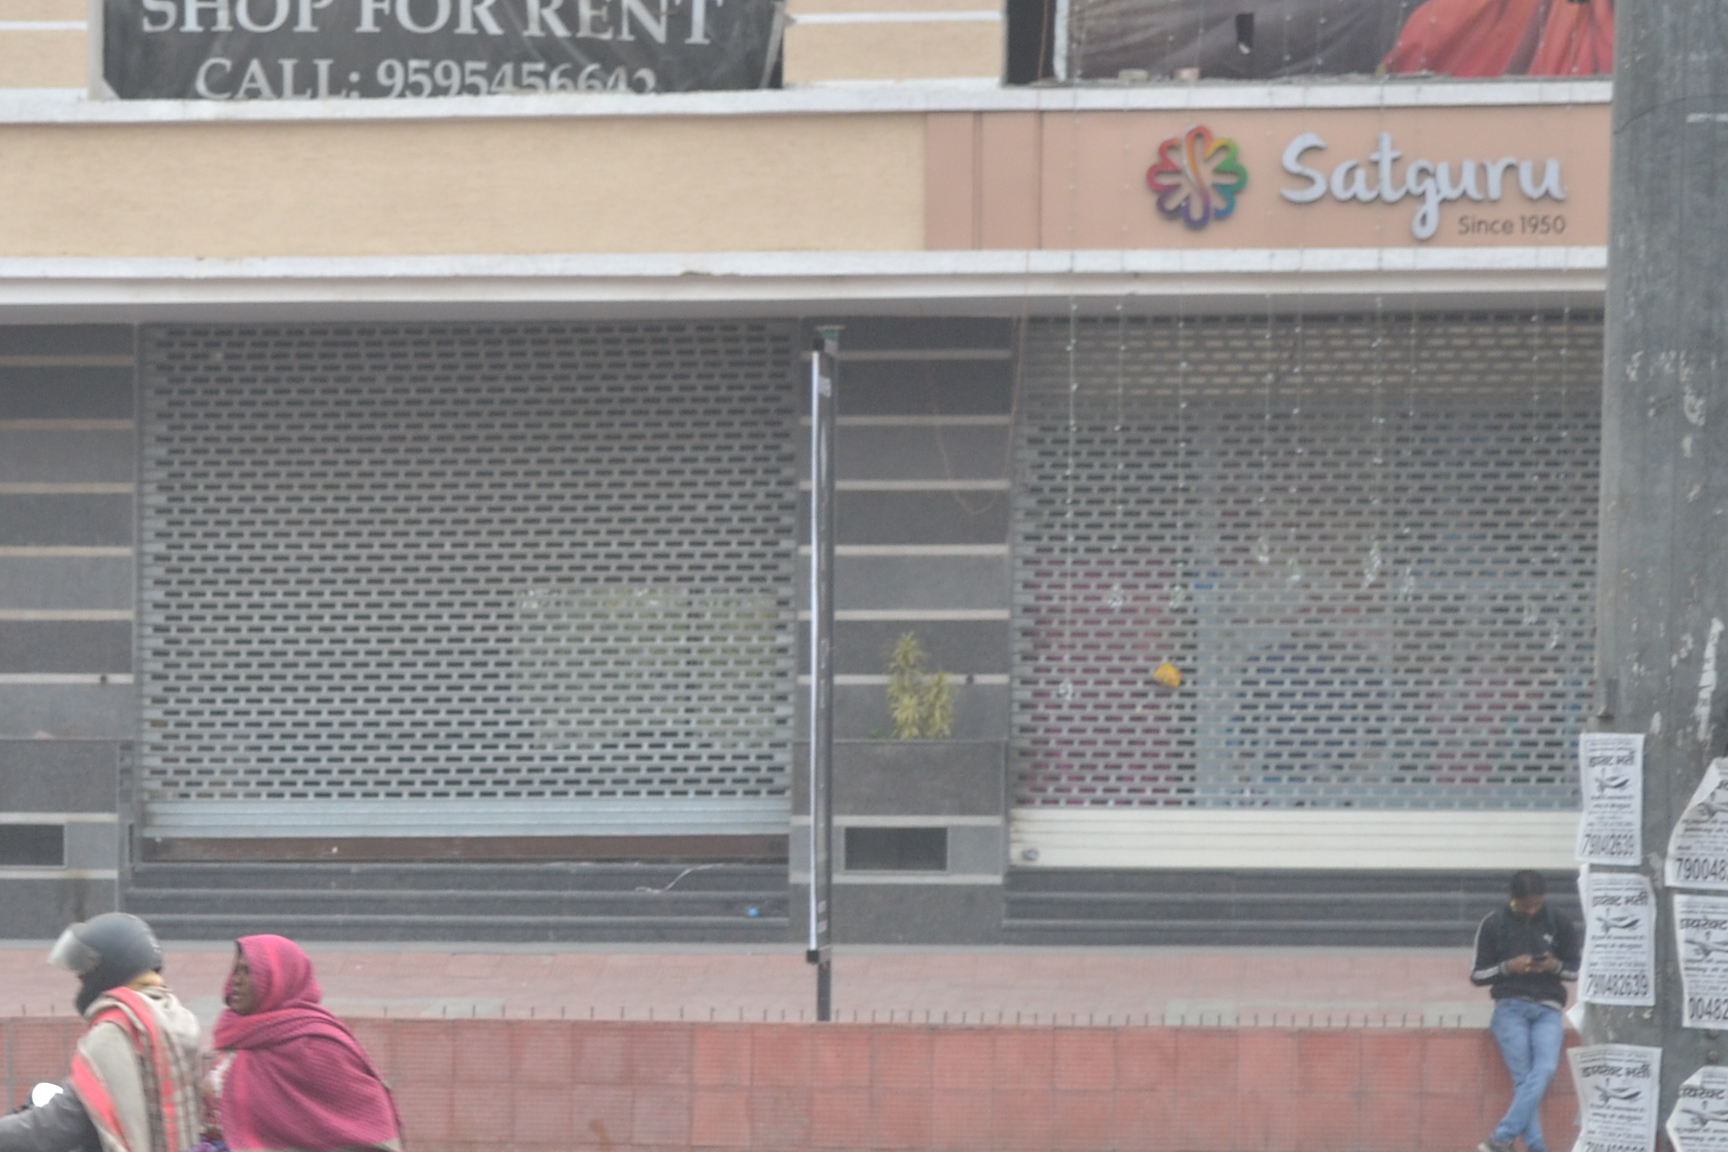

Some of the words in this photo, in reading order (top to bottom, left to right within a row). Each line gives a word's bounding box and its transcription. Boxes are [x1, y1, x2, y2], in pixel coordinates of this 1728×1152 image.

[142, 0, 334, 32] SHOP
[355, 0, 504, 36] FOR
[522, 0, 722, 44] RENT
[194, 57, 360, 99] CALL:
[1280, 131, 1567, 240] Satguru
[1458, 214, 1514, 234] Since
[1521, 214, 1566, 234] 1950
[1675, 858, 1728, 881] 790048
